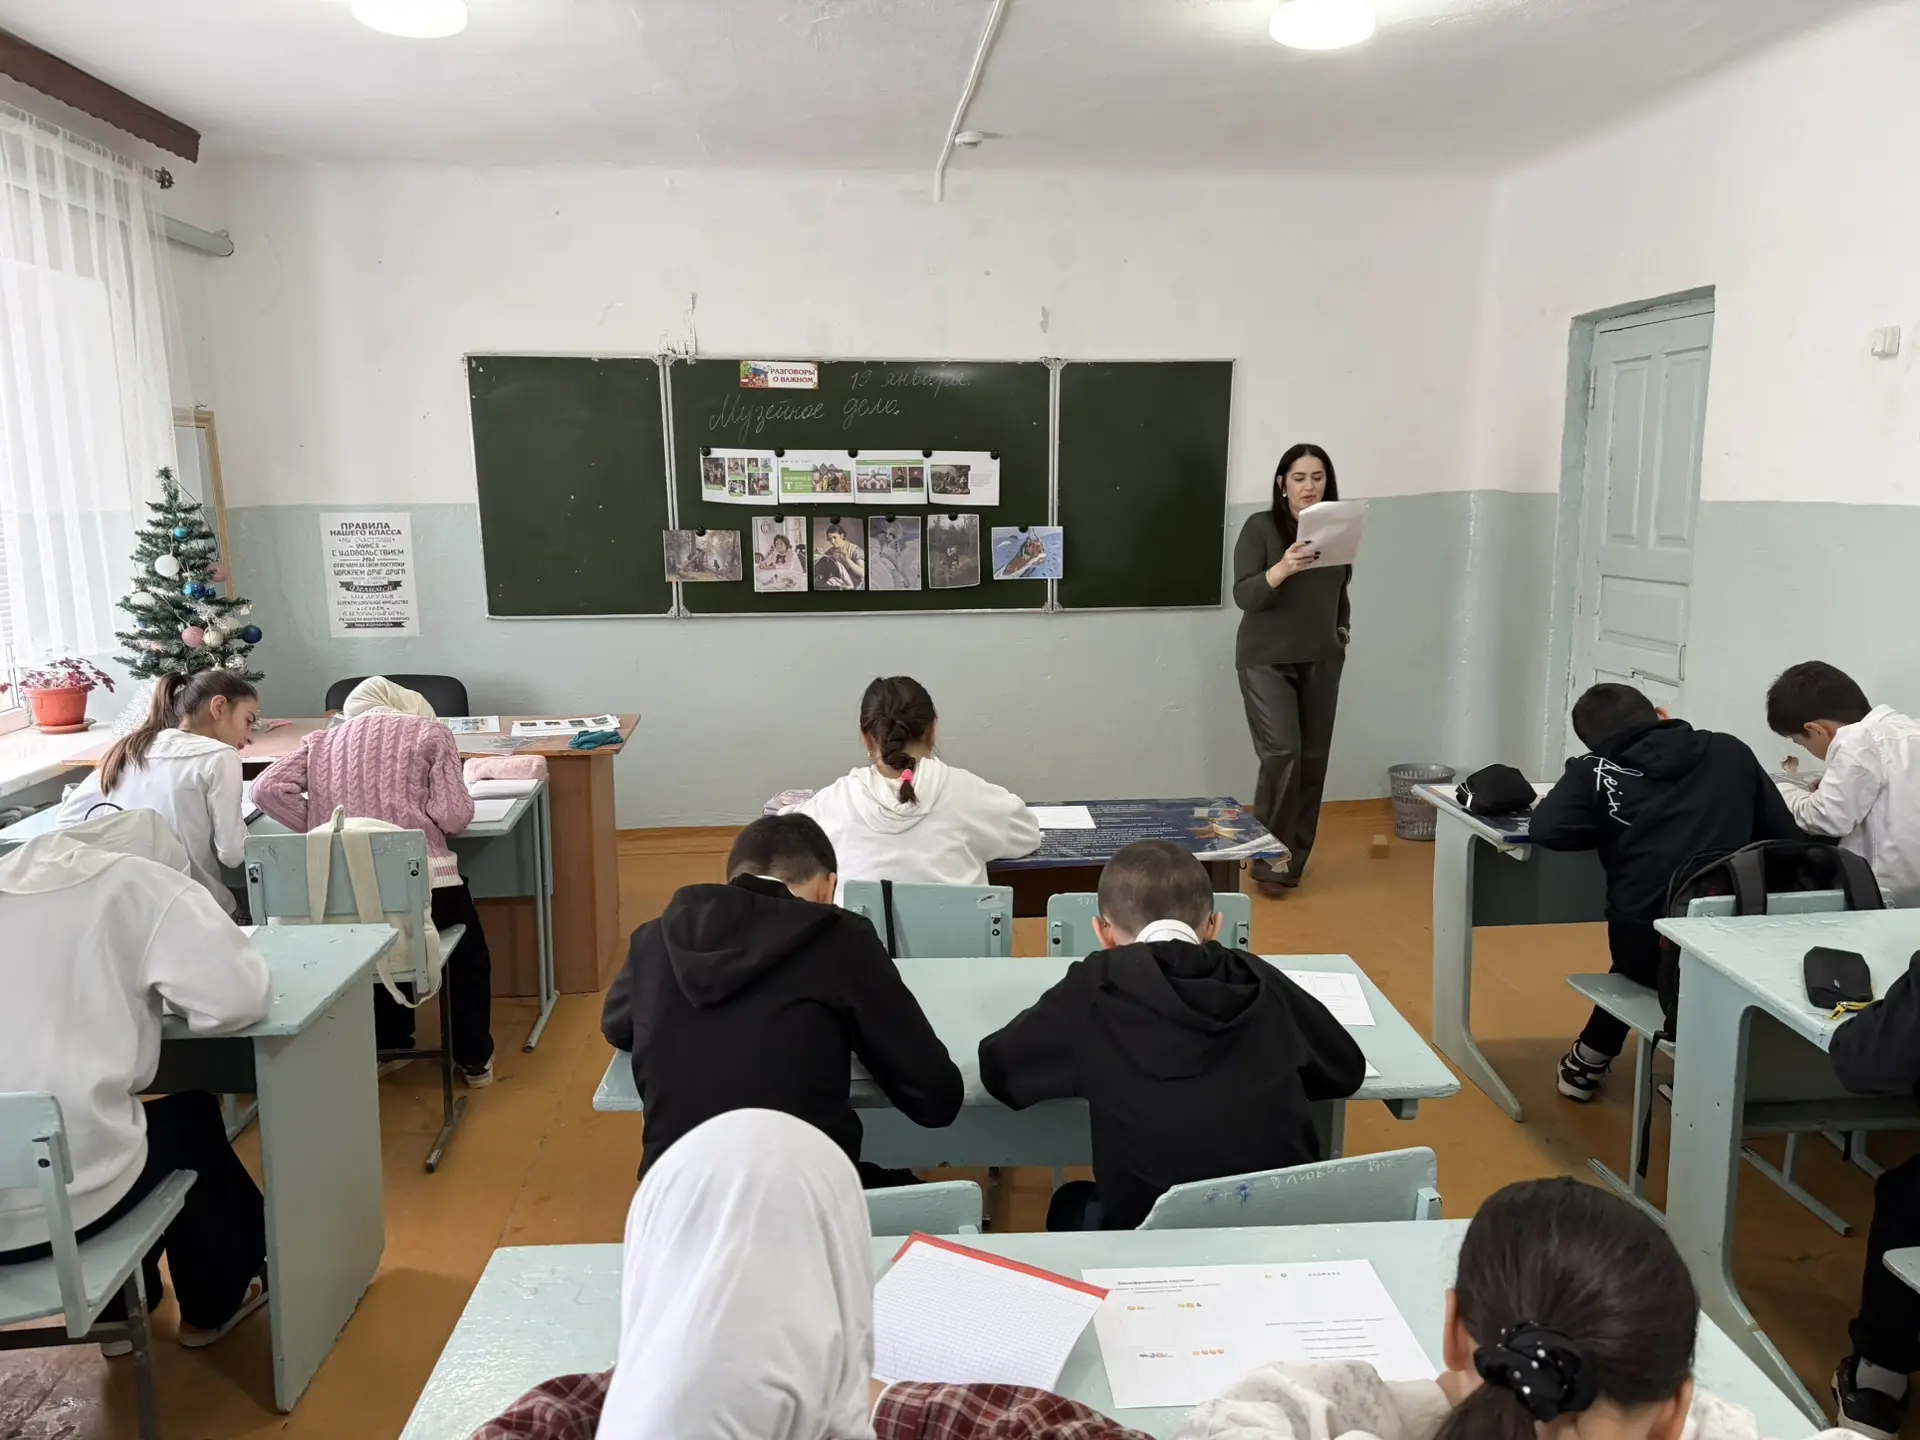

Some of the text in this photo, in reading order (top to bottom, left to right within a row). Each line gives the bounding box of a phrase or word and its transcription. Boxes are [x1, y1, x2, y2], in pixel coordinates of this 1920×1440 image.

[770, 368, 816, 376] РАЗГОВОРЫ
[850, 370, 871, 390] 19
[709, 394, 825, 444] Музейное
[340, 522, 391, 530] ПРАВИЛА
[329, 528, 402, 537] НАШЕГО КЛАССА
